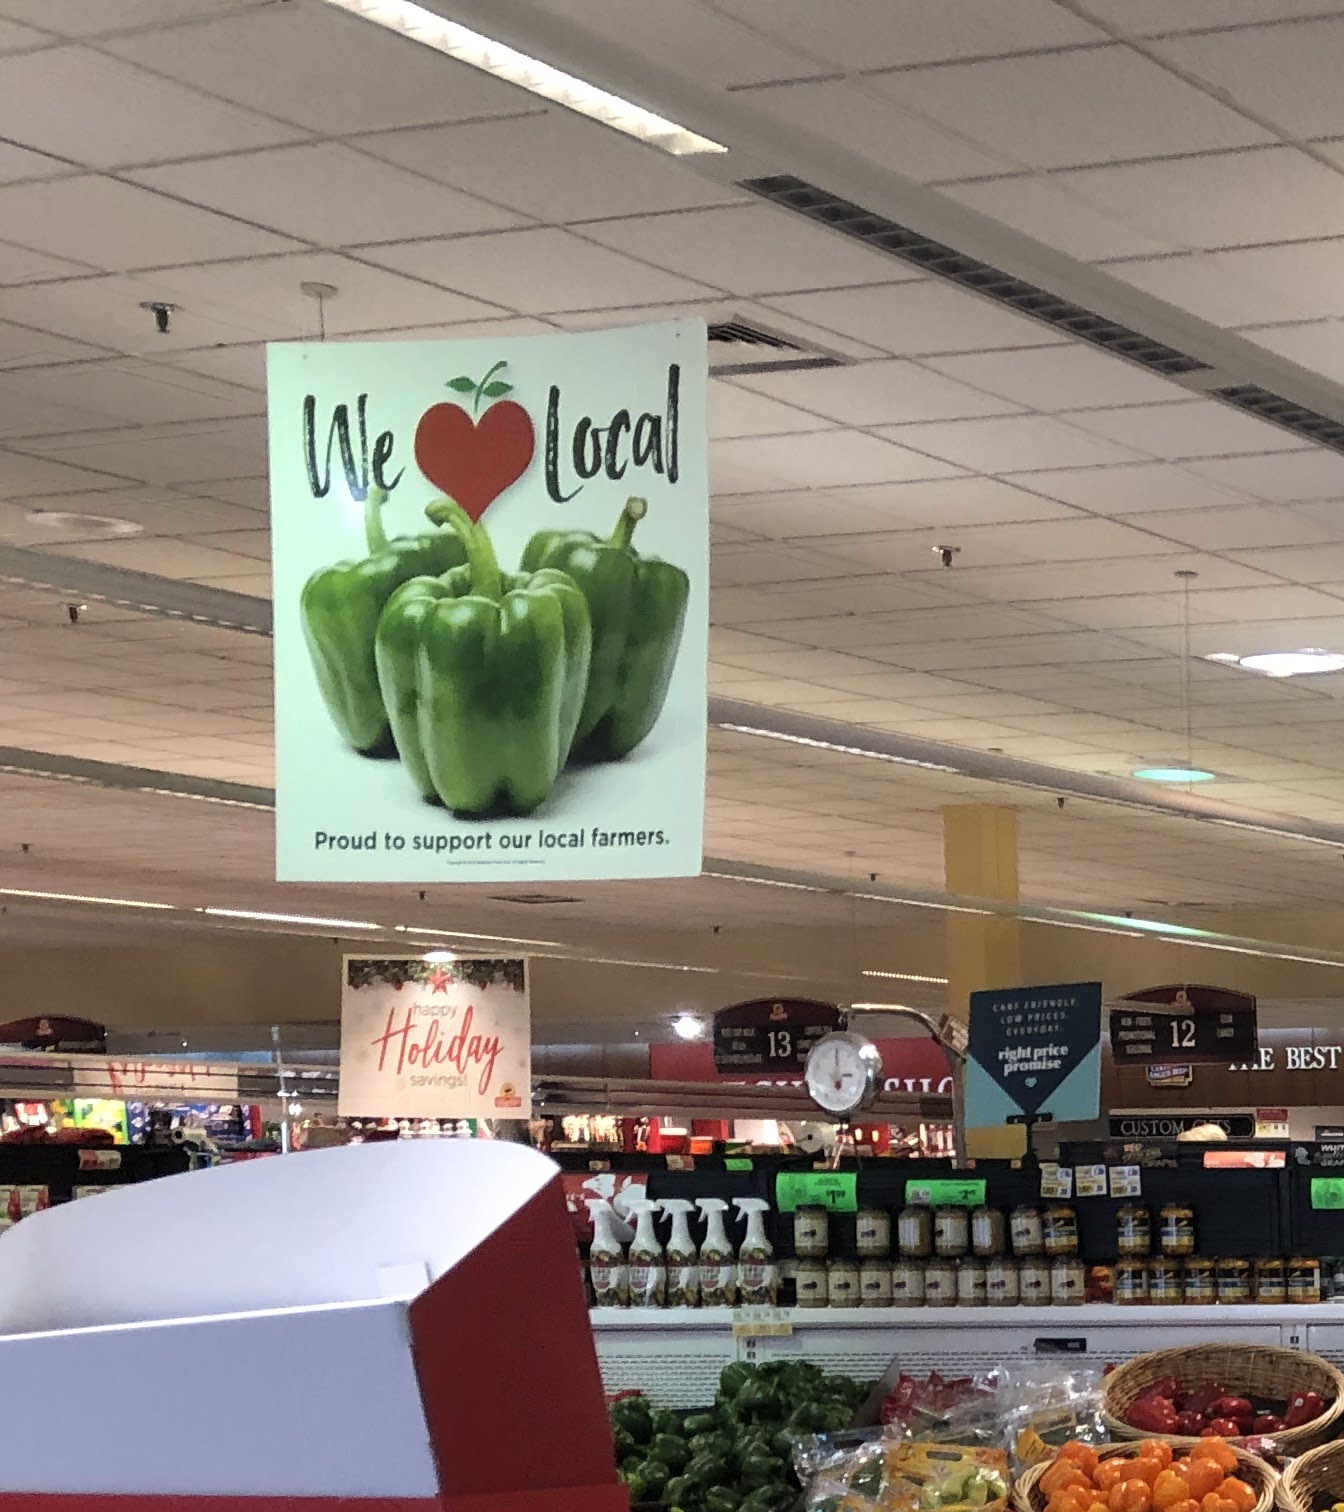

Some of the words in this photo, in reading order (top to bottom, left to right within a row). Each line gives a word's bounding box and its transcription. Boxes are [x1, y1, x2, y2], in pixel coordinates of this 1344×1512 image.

[304, 393, 406, 501] We
[546, 363, 680, 503] Local
[314, 831, 377, 850] Proud
[384, 833, 406, 851] to
[412, 832, 492, 854] support
[498, 832, 532, 849] our
[539, 829, 585, 849] local
[591, 827, 671, 848] farmers.
[413, 1002, 458, 1019] happy
[767, 1031, 791, 1058] 13
[1170, 1019, 1196, 1048] 12
[371, 1005, 504, 1096] Holiday
[998, 1046, 1032, 1063] right
[1033, 1043, 1069, 1060] price
[1286, 1046, 1342, 1070] BEST
[1003, 1058, 1062, 1077] promise
[1120, 1119, 1184, 1137] CUSTOM
